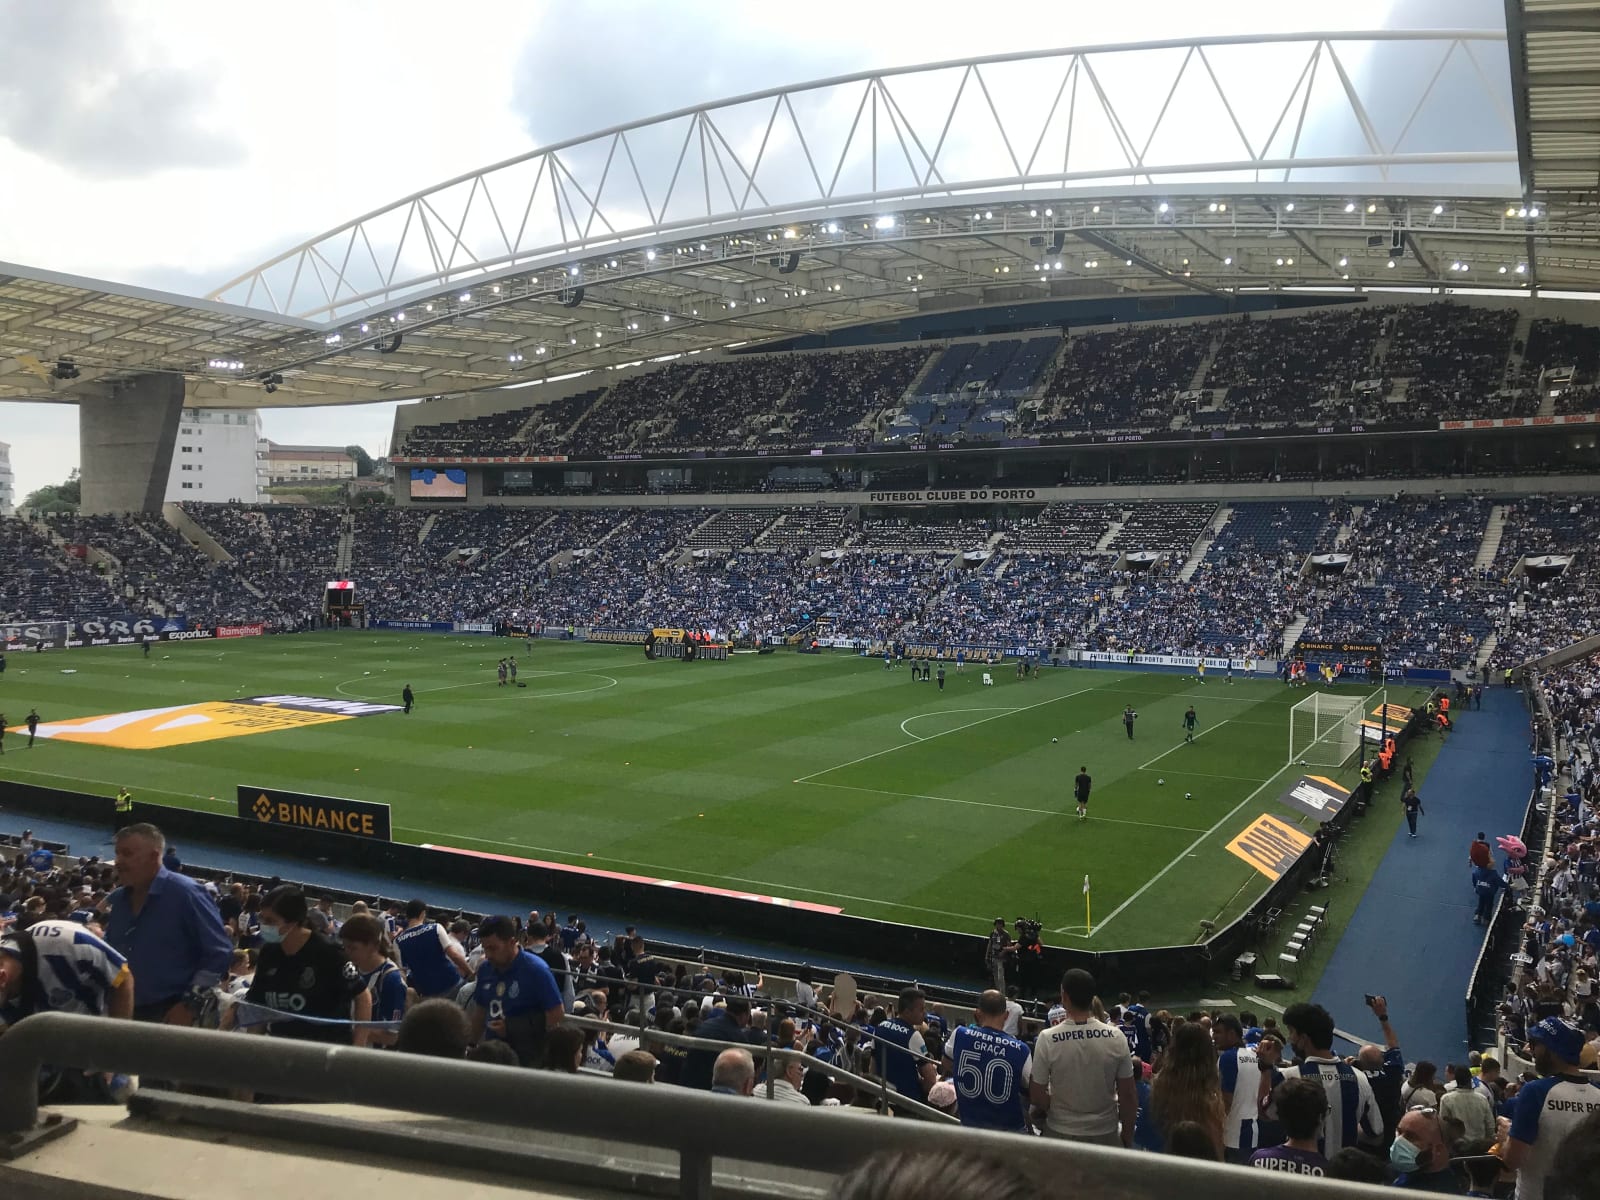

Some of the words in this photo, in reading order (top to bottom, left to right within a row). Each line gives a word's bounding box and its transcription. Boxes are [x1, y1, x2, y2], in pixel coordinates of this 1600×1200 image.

[870, 492, 922, 502] FUTEBOL
[926, 491, 966, 501] CLUBE
[970, 490, 988, 500] DO
[992, 489, 1035, 499] PORTO
[278, 802, 375, 835] BINANCE
[965, 1028, 994, 1043] SUPER
[995, 1036, 1022, 1051] BOCK
[1051, 1029, 1085, 1043] SUPER
[1086, 1028, 1115, 1040] BOCK
[973, 1040, 1007, 1057] GRAÇA
[957, 1049, 1014, 1105] 50
[1547, 1099, 1585, 1113] SUPER
[1254, 1157, 1297, 1173] SUPER
